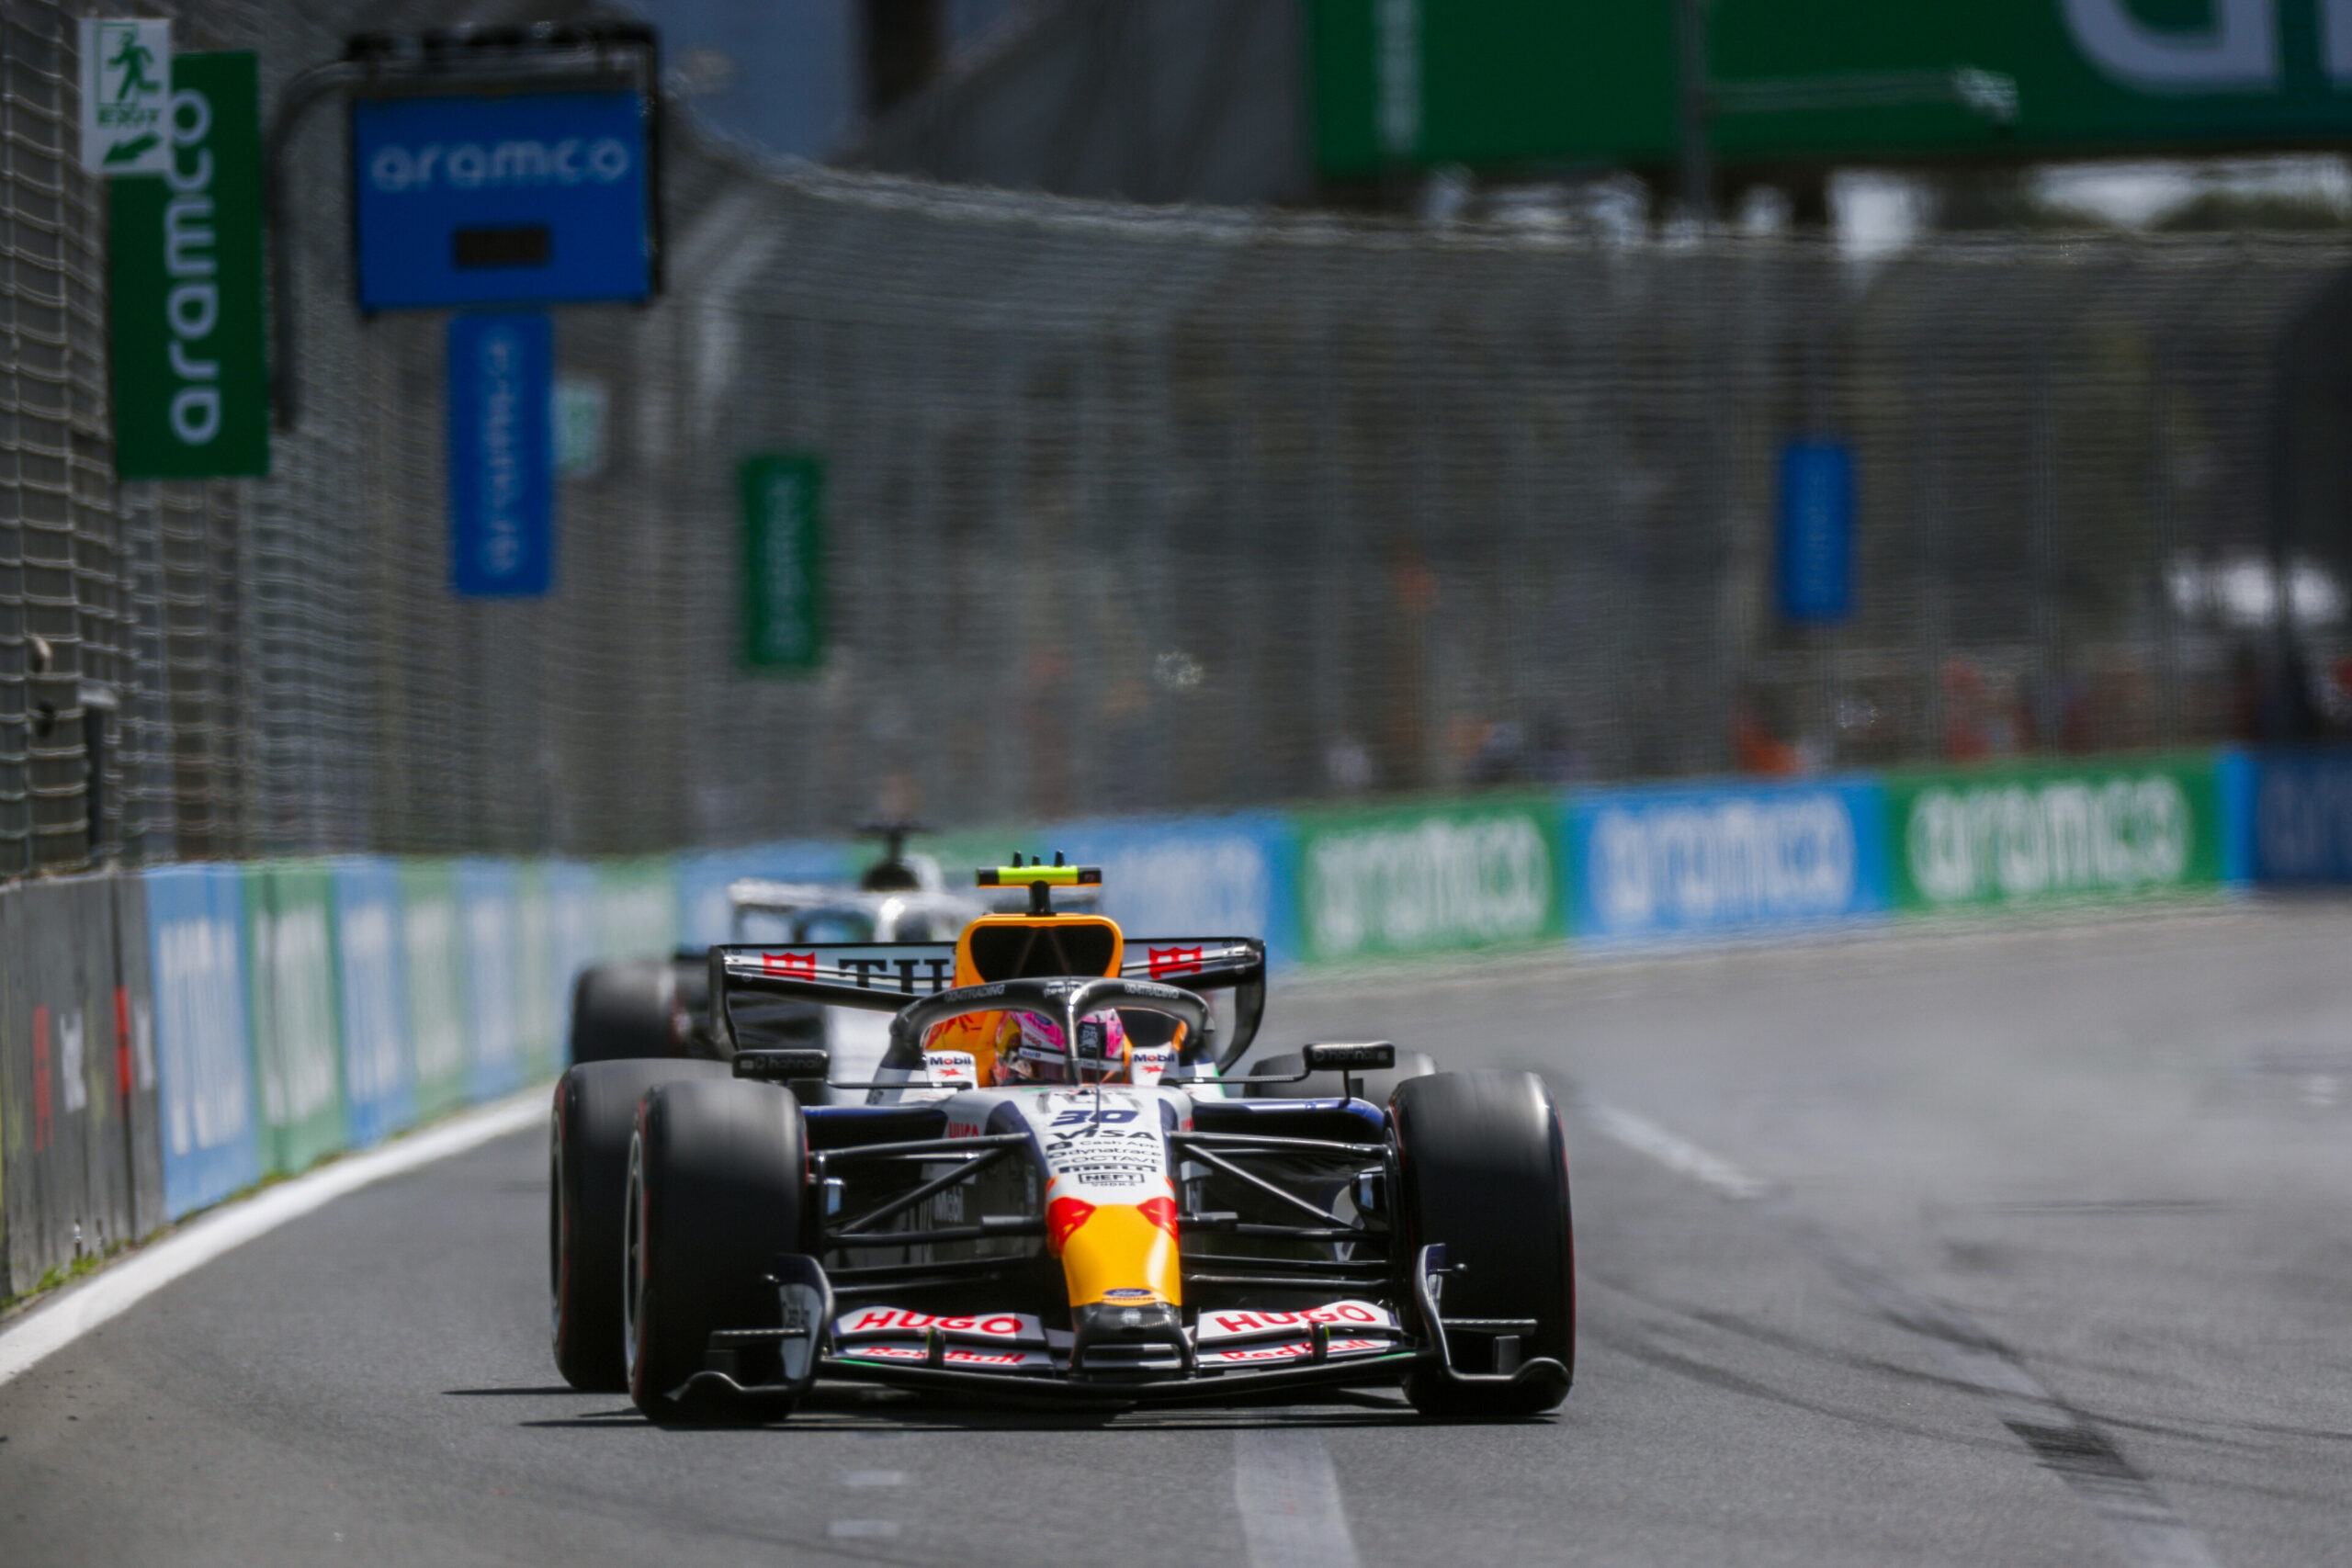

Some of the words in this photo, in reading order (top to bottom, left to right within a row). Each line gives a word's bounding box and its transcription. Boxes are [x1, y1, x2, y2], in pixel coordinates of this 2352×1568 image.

[371, 137, 631, 191] aramco
[164, 89, 221, 445] aramco
[930, 1056, 971, 1066] Mobil
[1134, 1054, 1175, 1063] Mobil
[1049, 1110, 1139, 1127] 30
[1051, 1127, 1157, 1141] VISA
[1069, 1147, 1162, 1157] dynatrace
[853, 1311, 1023, 1334] HUGO
[1214, 1304, 1376, 1333] HUGO
[944, 1349, 1027, 1364] Bull
[1219, 1344, 1303, 1360] Red
